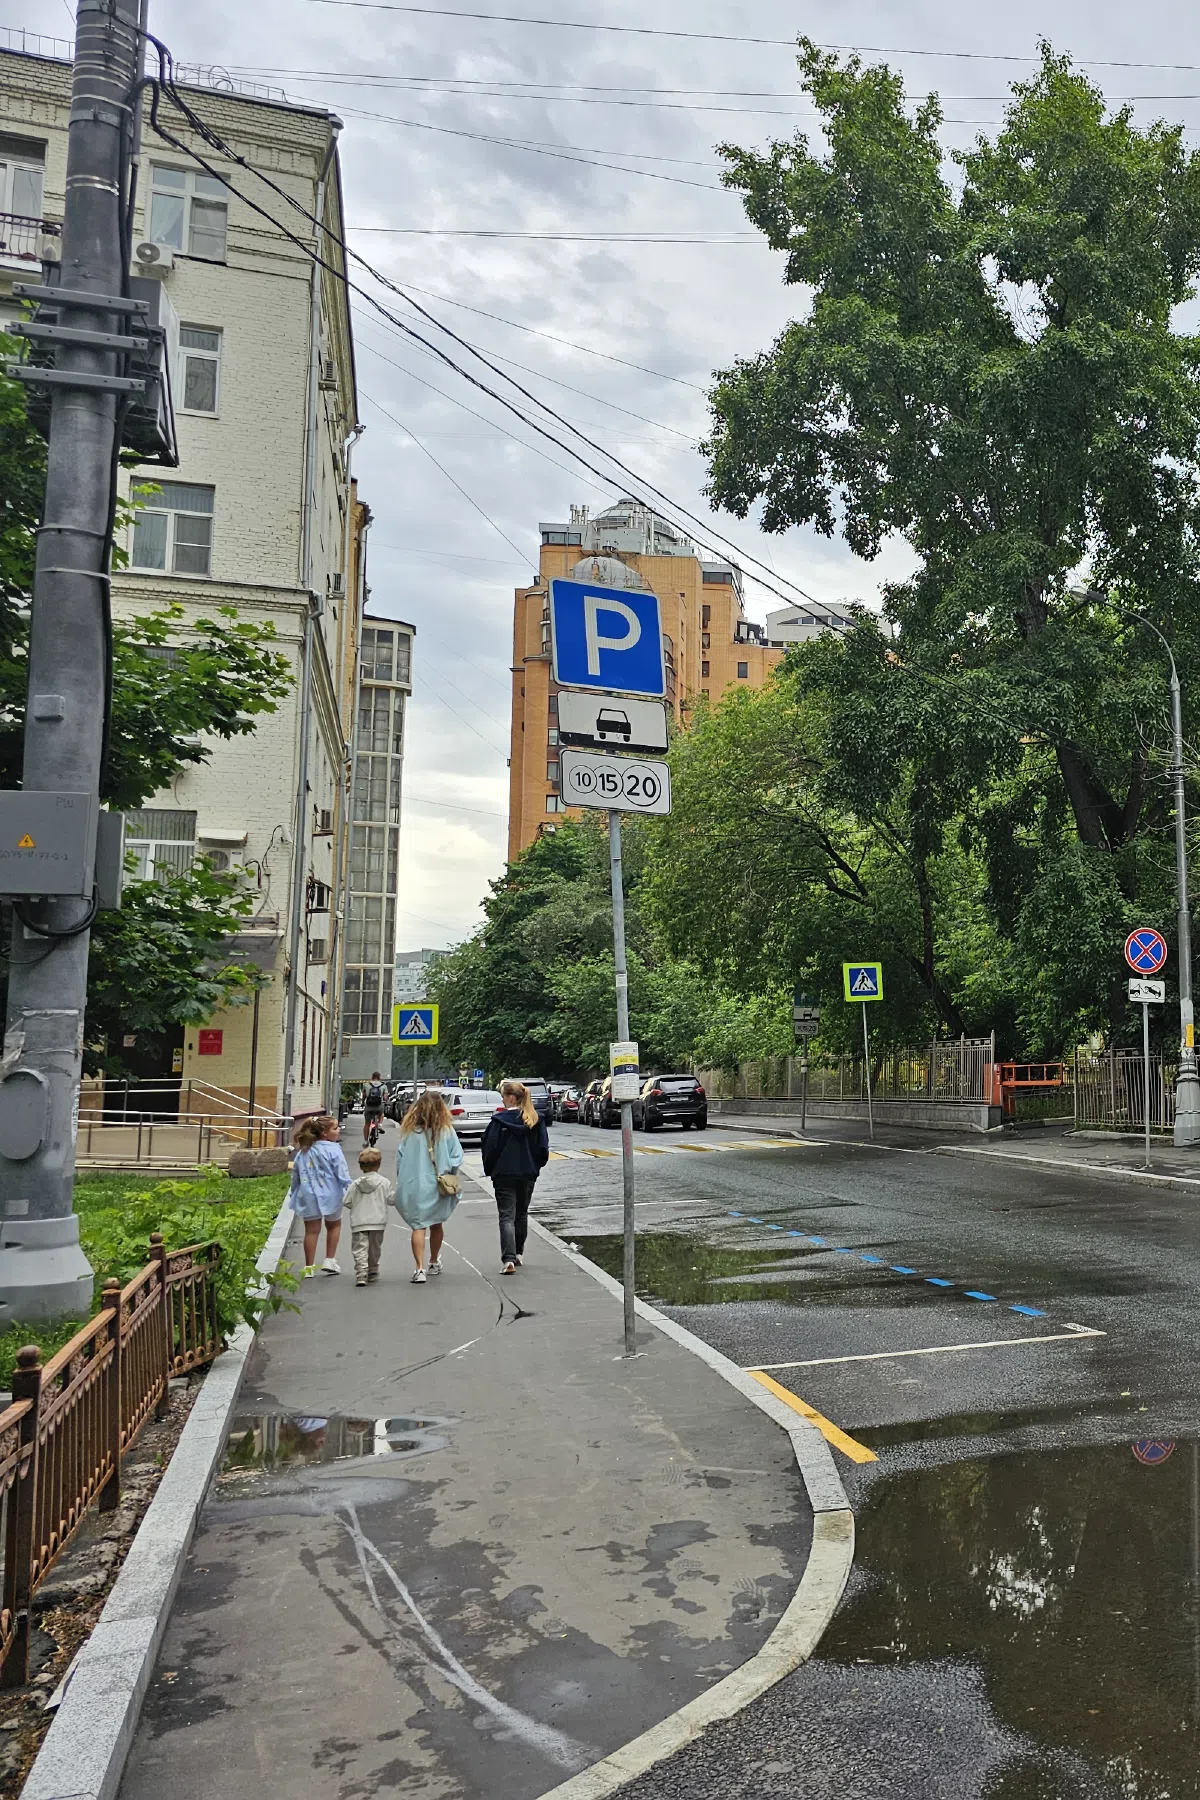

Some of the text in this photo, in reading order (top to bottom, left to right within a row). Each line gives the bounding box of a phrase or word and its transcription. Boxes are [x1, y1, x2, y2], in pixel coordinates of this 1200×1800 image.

[584, 596, 641, 676] P
[575, 771, 657, 798] 10 15 20
